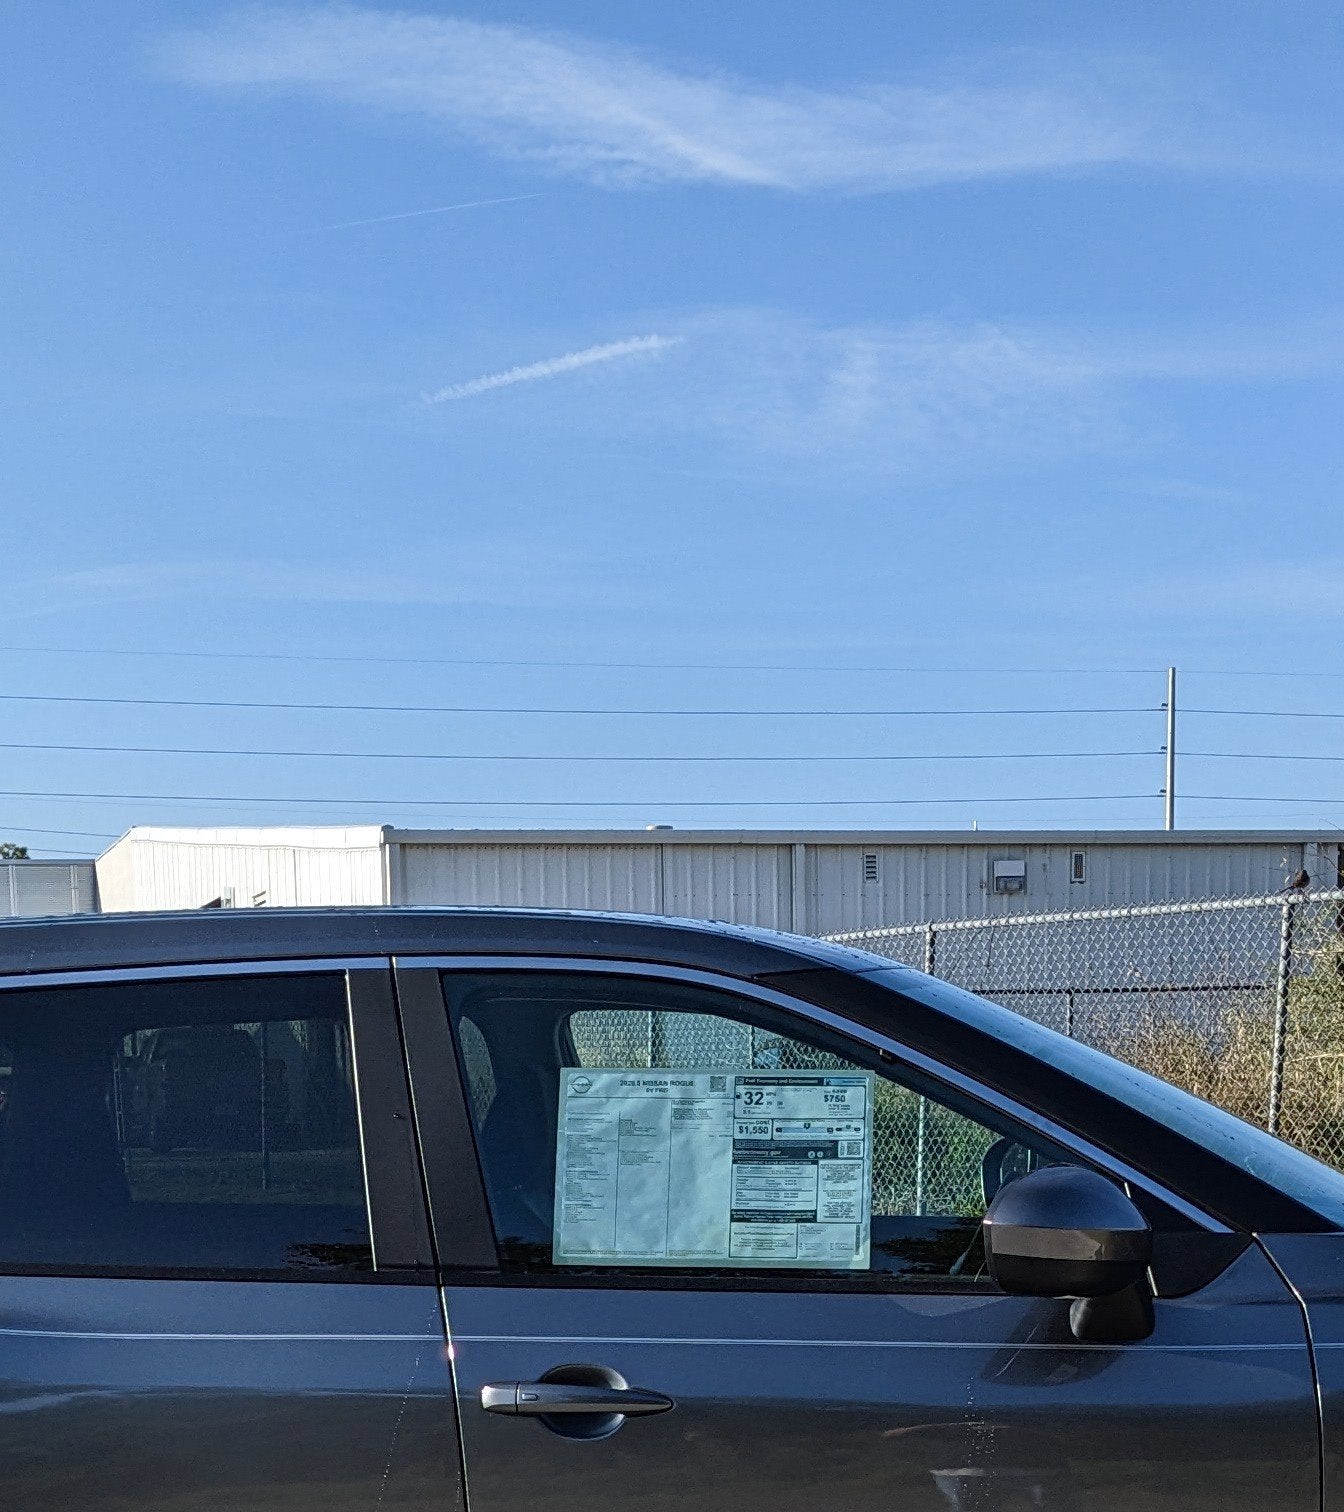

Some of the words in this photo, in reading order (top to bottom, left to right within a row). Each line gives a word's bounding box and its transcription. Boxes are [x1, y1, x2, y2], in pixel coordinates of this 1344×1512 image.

[744, 1091, 764, 1106] 32
[823, 1094, 846, 1103] $750
[738, 1125, 769, 1135] $1,550
